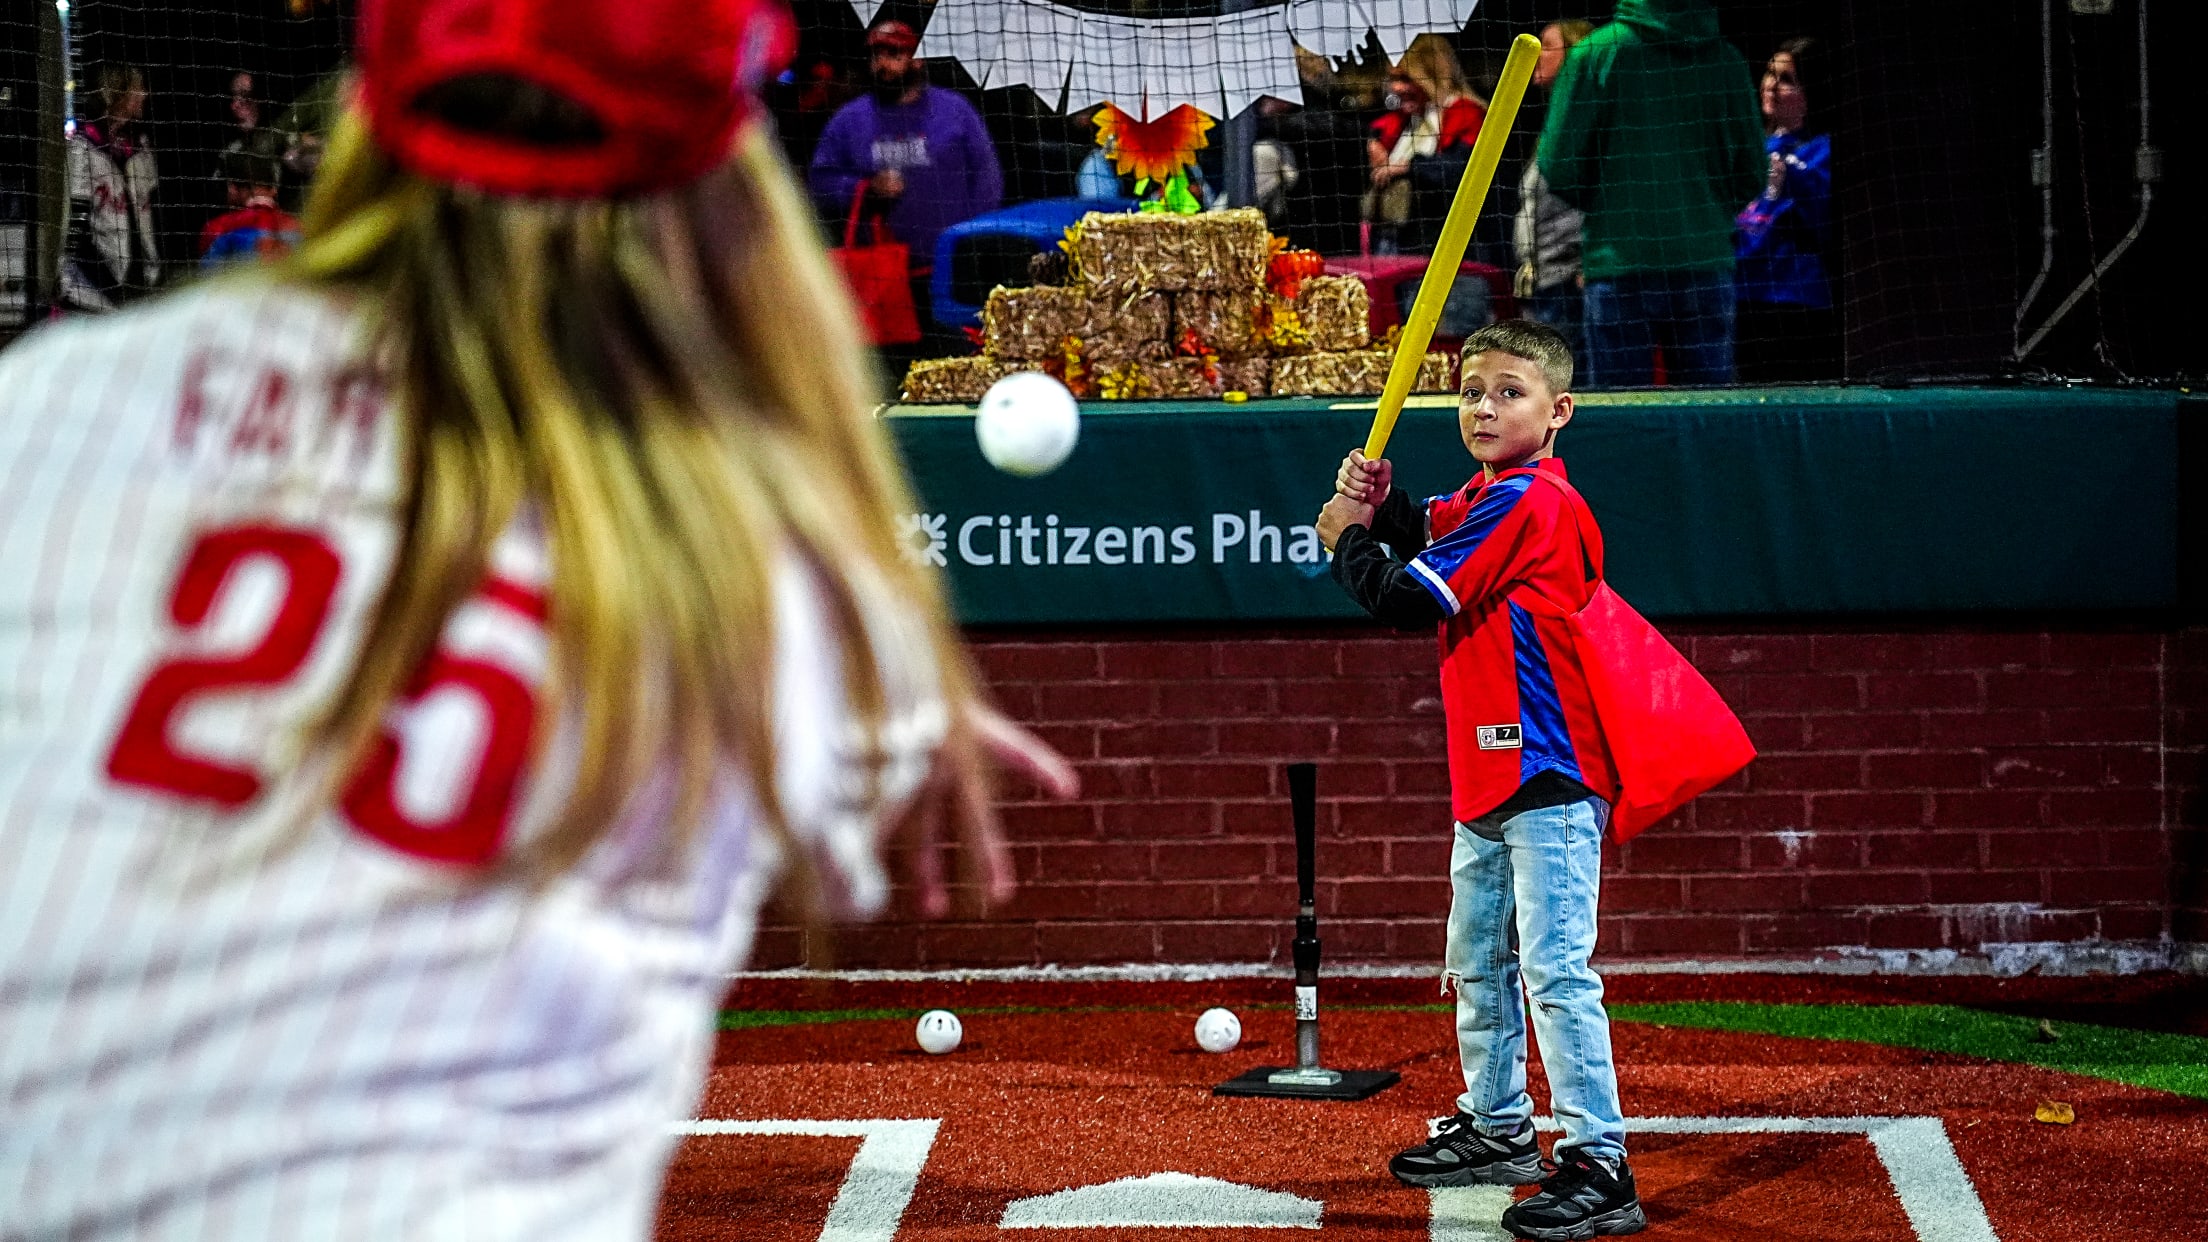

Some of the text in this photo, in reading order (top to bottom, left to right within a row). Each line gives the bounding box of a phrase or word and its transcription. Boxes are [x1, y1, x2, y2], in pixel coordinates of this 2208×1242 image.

[957, 509, 1334, 566] Citizens Pha
[1502, 728, 1511, 738] 7
